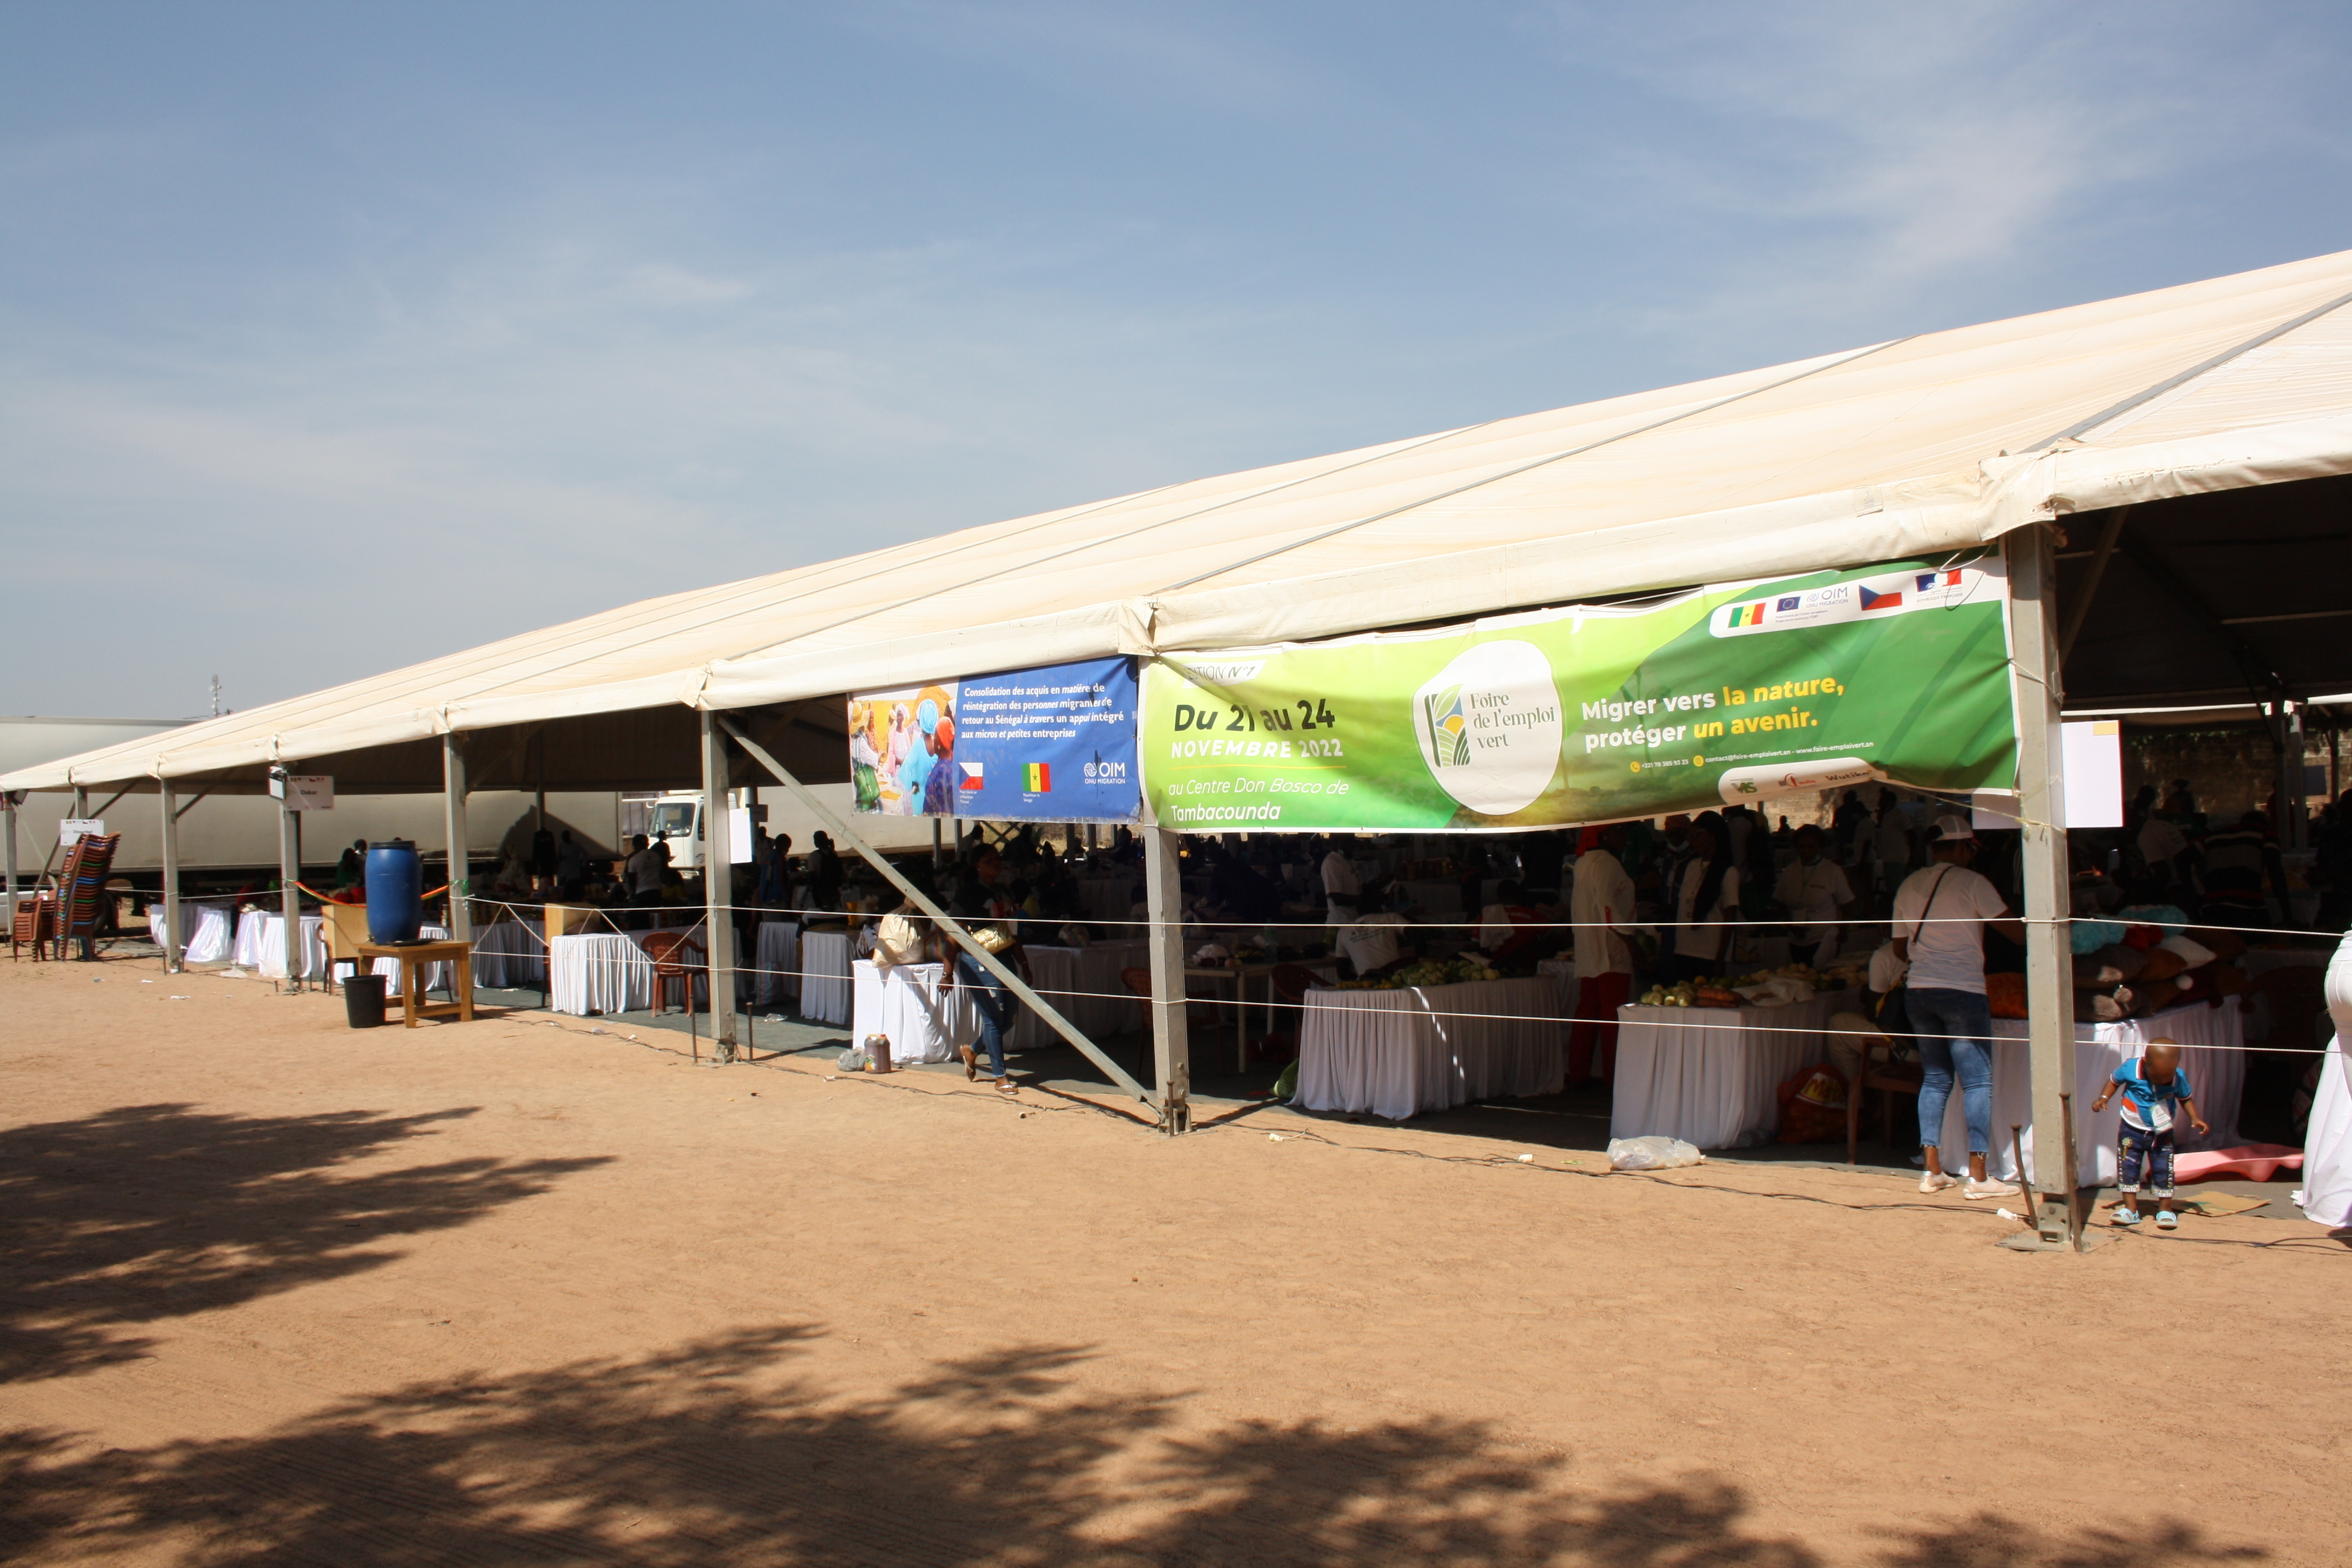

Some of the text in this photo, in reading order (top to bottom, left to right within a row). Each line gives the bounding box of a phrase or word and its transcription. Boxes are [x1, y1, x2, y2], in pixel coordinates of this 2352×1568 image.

[1821, 587, 1848, 600] OIM
[1819, 598, 1849, 607] MIGRATION
[964, 687, 1011, 697] Consolidation
[1012, 686, 1024, 695] des
[1026, 685, 1049, 697] acquis
[1062, 684, 1091, 694] matière
[1093, 682, 1105, 692] de
[962, 701, 1007, 713] réintégration
[1009, 701, 1022, 710] des
[1023, 701, 1058, 713] personnes
[1101, 696, 1112, 707] de
[1470, 693, 1510, 710] Foire
[1581, 676, 1845, 722] Migrer vers la nature,
[962, 716, 984, 725] retour
[995, 714, 1022, 727] Sénégal
[1024, 714, 1028, 724] à
[1029, 714, 1054, 724] travers
[1069, 713, 1091, 725] appui
[1091, 711, 1124, 724] intégré
[1174, 698, 1336, 731] Du 21 au 24
[1474, 713, 1491, 729] de
[975, 729, 998, 739] micros
[1007, 728, 1031, 740] petites
[1033, 728, 1076, 740] entreprises
[1584, 706, 1818, 754] protéger un avenir.
[1171, 739, 1344, 759] NOVEMBRE 2022
[1477, 733, 1509, 749] vert
[1099, 762, 1125, 777] OIM
[1169, 777, 1350, 796] au Centre Don Bosco de
[1171, 801, 1282, 822] Tambacounda
